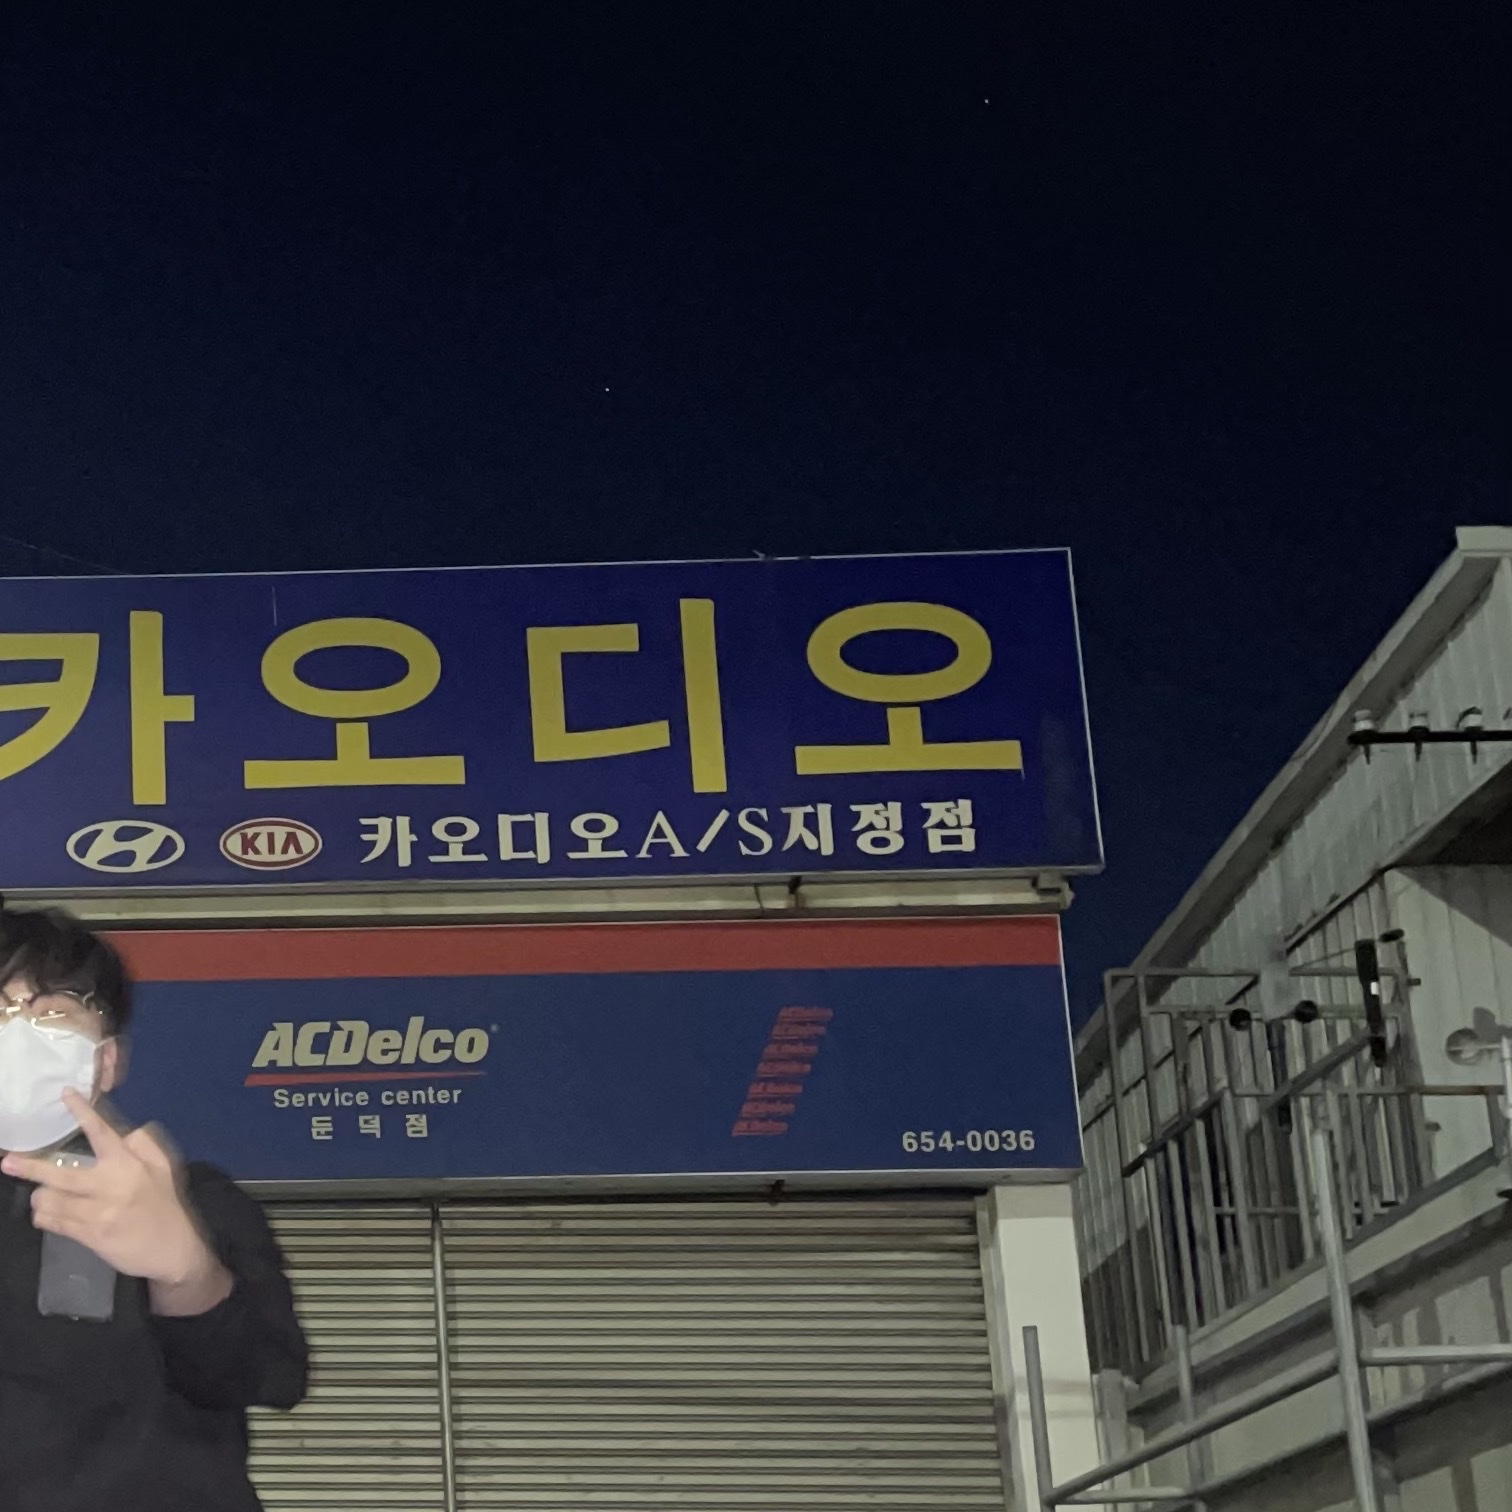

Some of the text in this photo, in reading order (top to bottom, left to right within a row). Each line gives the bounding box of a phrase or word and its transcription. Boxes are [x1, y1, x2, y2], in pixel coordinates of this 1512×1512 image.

[252, 1016, 490, 1068] ACDelco
[273, 1086, 463, 1108] Service center
[902, 1129, 1036, 1152] 654-0036
